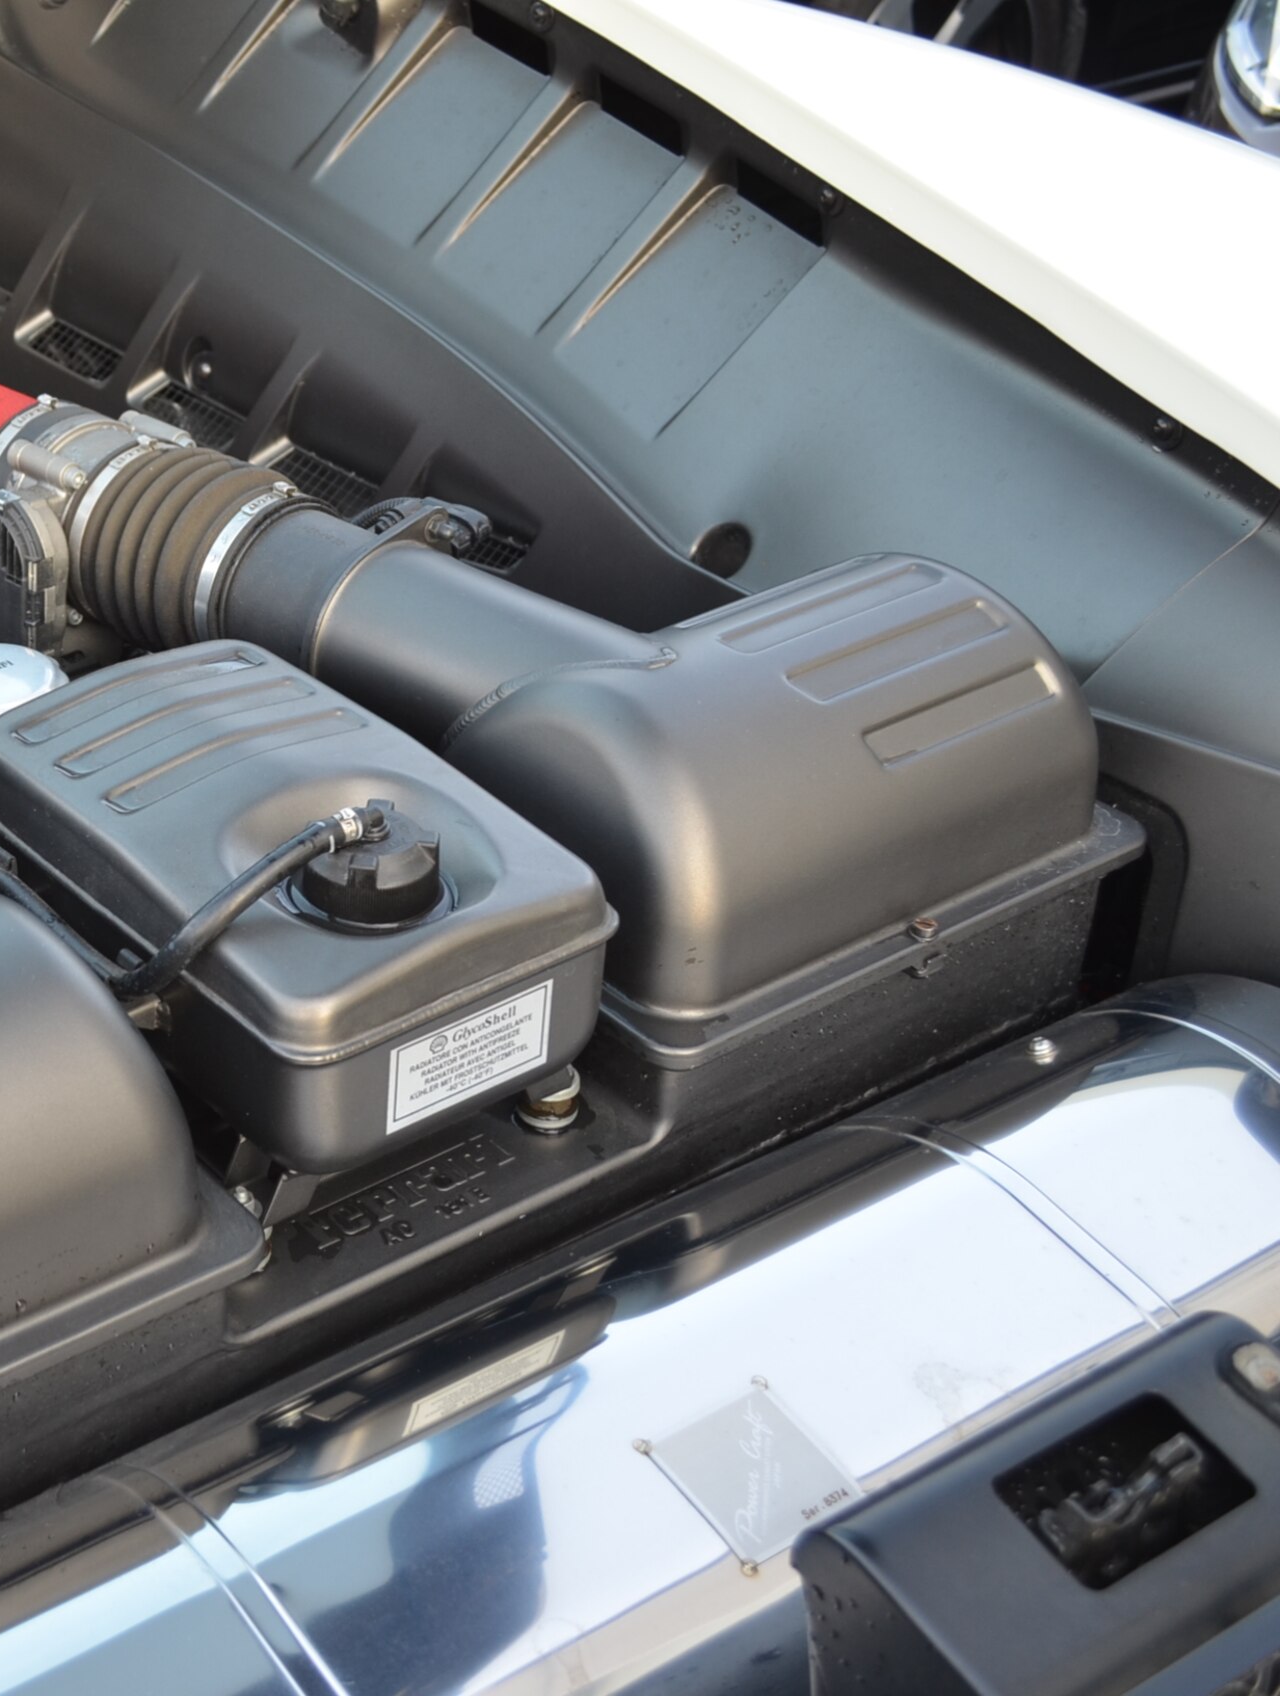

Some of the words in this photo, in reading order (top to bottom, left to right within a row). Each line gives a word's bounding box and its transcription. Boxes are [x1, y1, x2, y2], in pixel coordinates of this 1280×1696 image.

[409, 1048, 450, 1074] RADIATORE
[452, 1040, 468, 1054] CON
[469, 1012, 533, 1047] ANTICONGELANTE
[452, 1004, 517, 1043] GlycoShell
[420, 1055, 457, 1078] RADIATOR
[458, 1046, 477, 1061] WITH
[478, 1027, 520, 1052] ANTIFREEZE
[424, 1061, 465, 1086] RADIATEUR
[465, 1051, 485, 1067] AVEC
[486, 1038, 516, 1058] ANTIGEL
[440, 1075, 453, 1088] MIT
